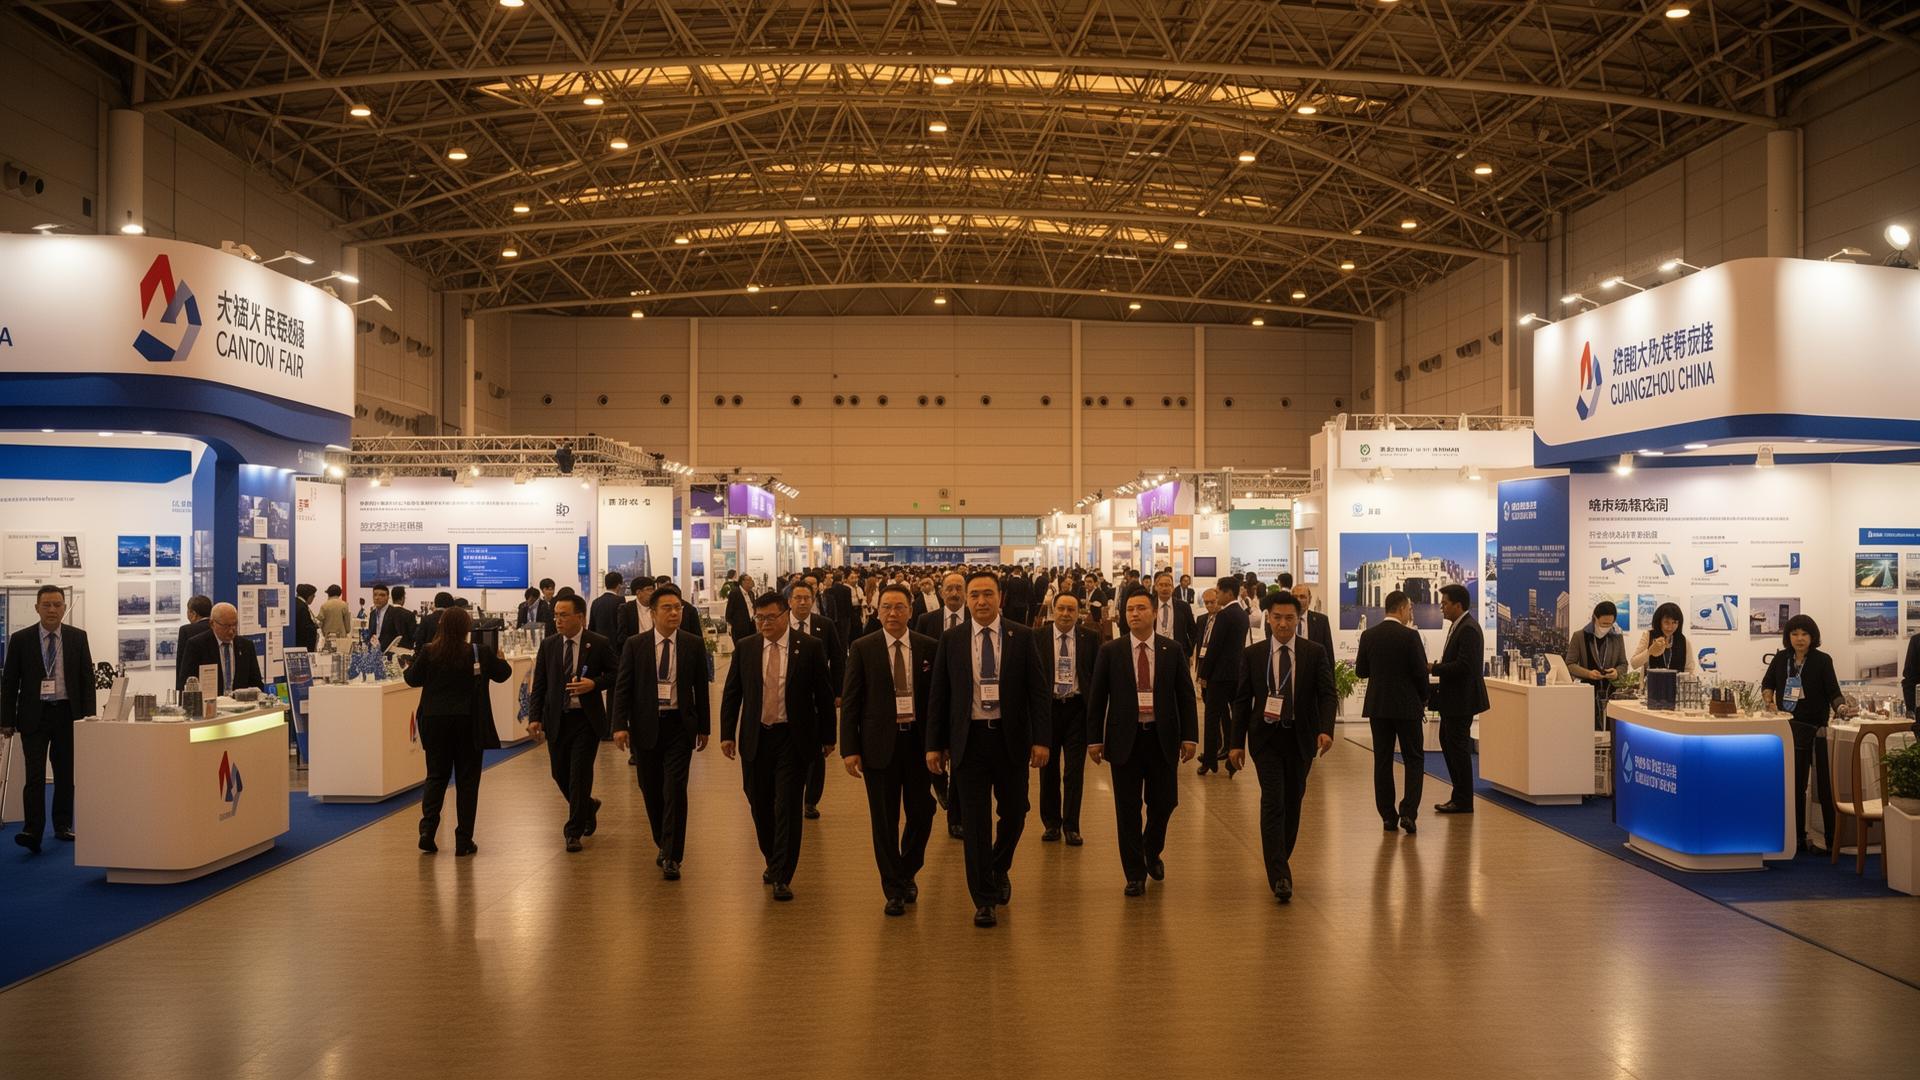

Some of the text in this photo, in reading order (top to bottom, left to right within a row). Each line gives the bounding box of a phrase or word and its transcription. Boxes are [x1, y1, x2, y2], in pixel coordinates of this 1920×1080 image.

[216, 330, 304, 379] CANTON FAIR
[1678, 360, 1715, 391] CHINA
